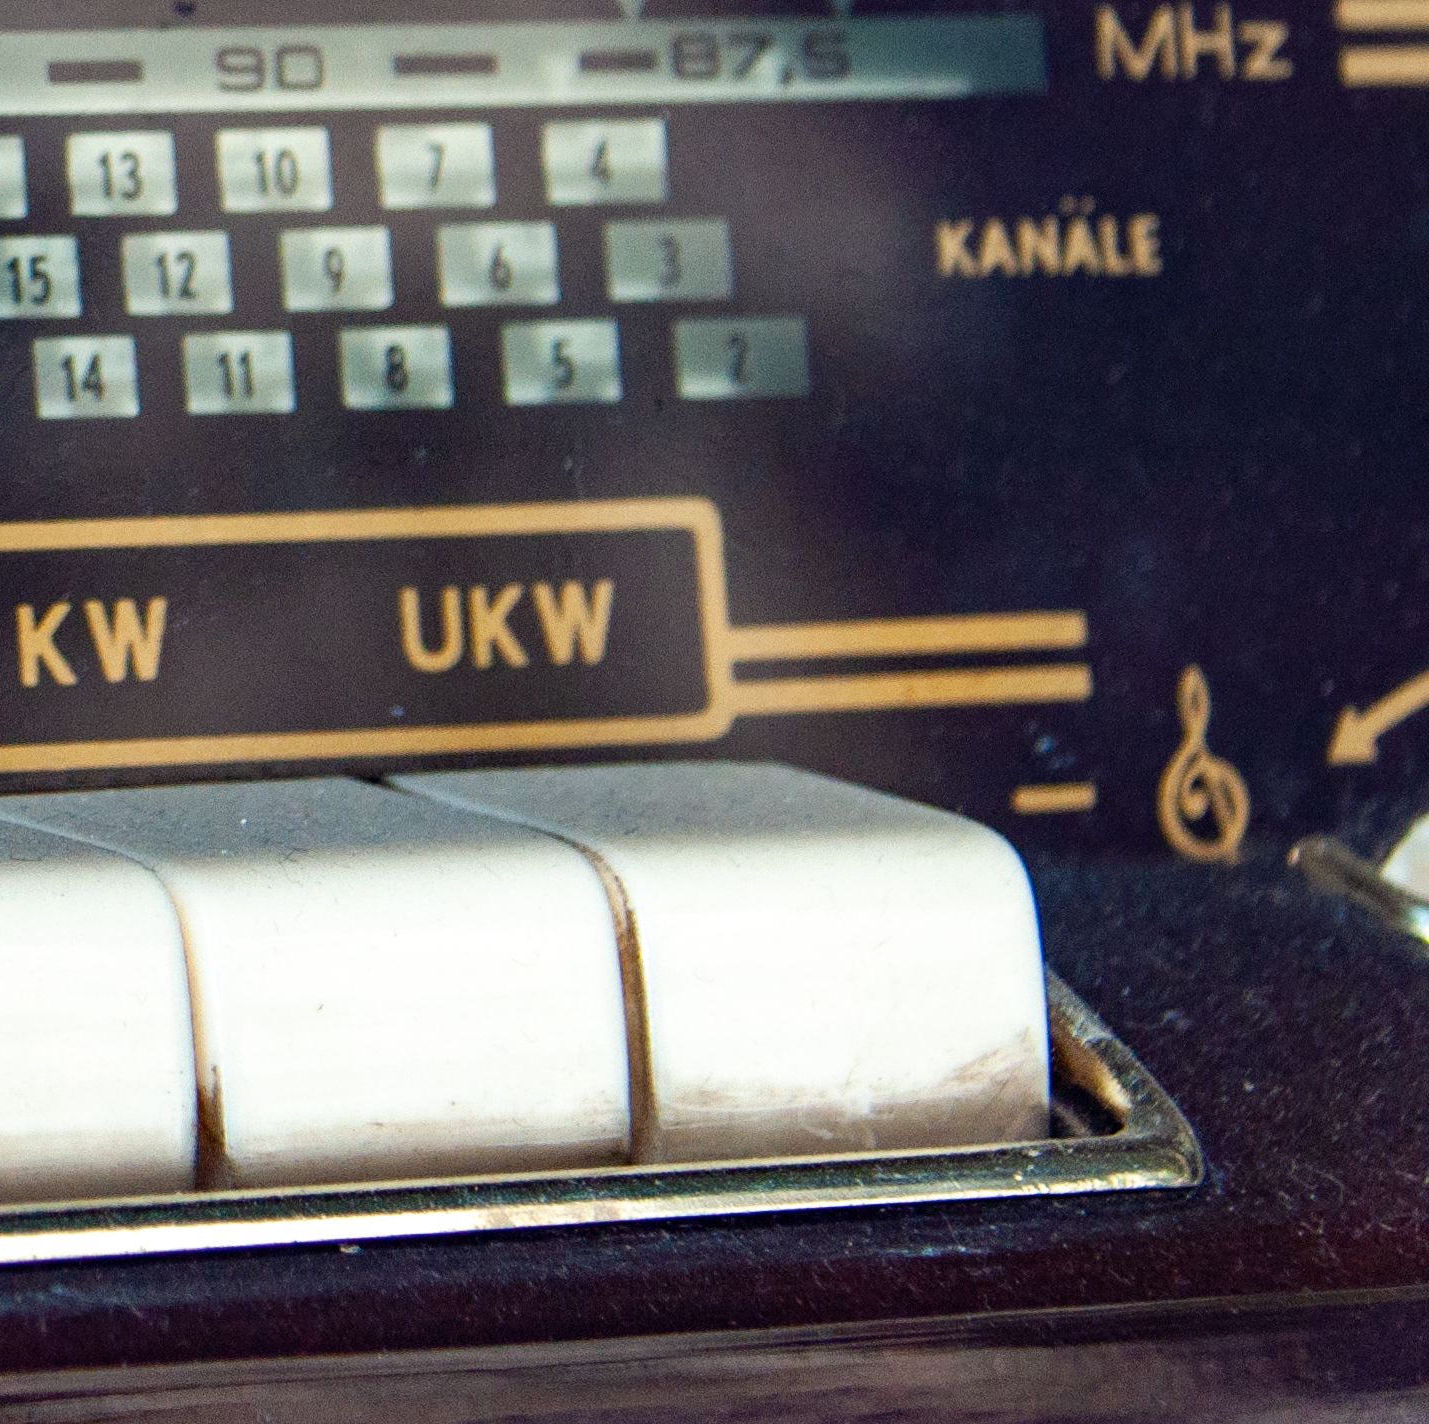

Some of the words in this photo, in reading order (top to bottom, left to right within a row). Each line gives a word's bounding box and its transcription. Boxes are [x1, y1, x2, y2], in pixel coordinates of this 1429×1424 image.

[216, 46, 325, 93] 90
[1095, 1, 1293, 82] MHz
[97, 150, 144, 201] 13
[253, 147, 299, 198] 10
[421, 141, 444, 190] 7
[937, 195, 1163, 277] KANÄLE
[5, 253, 52, 305] 15
[154, 249, 199, 300] 12
[322, 245, 345, 294] 9
[488, 241, 512, 291] 6
[60, 353, 106, 404] 14
[215, 350, 254, 401] 11
[384, 344, 409, 394] 8
[549, 339, 574, 389] 5
[16, 597, 168, 688] KW
[400, 579, 615, 674] UKW
